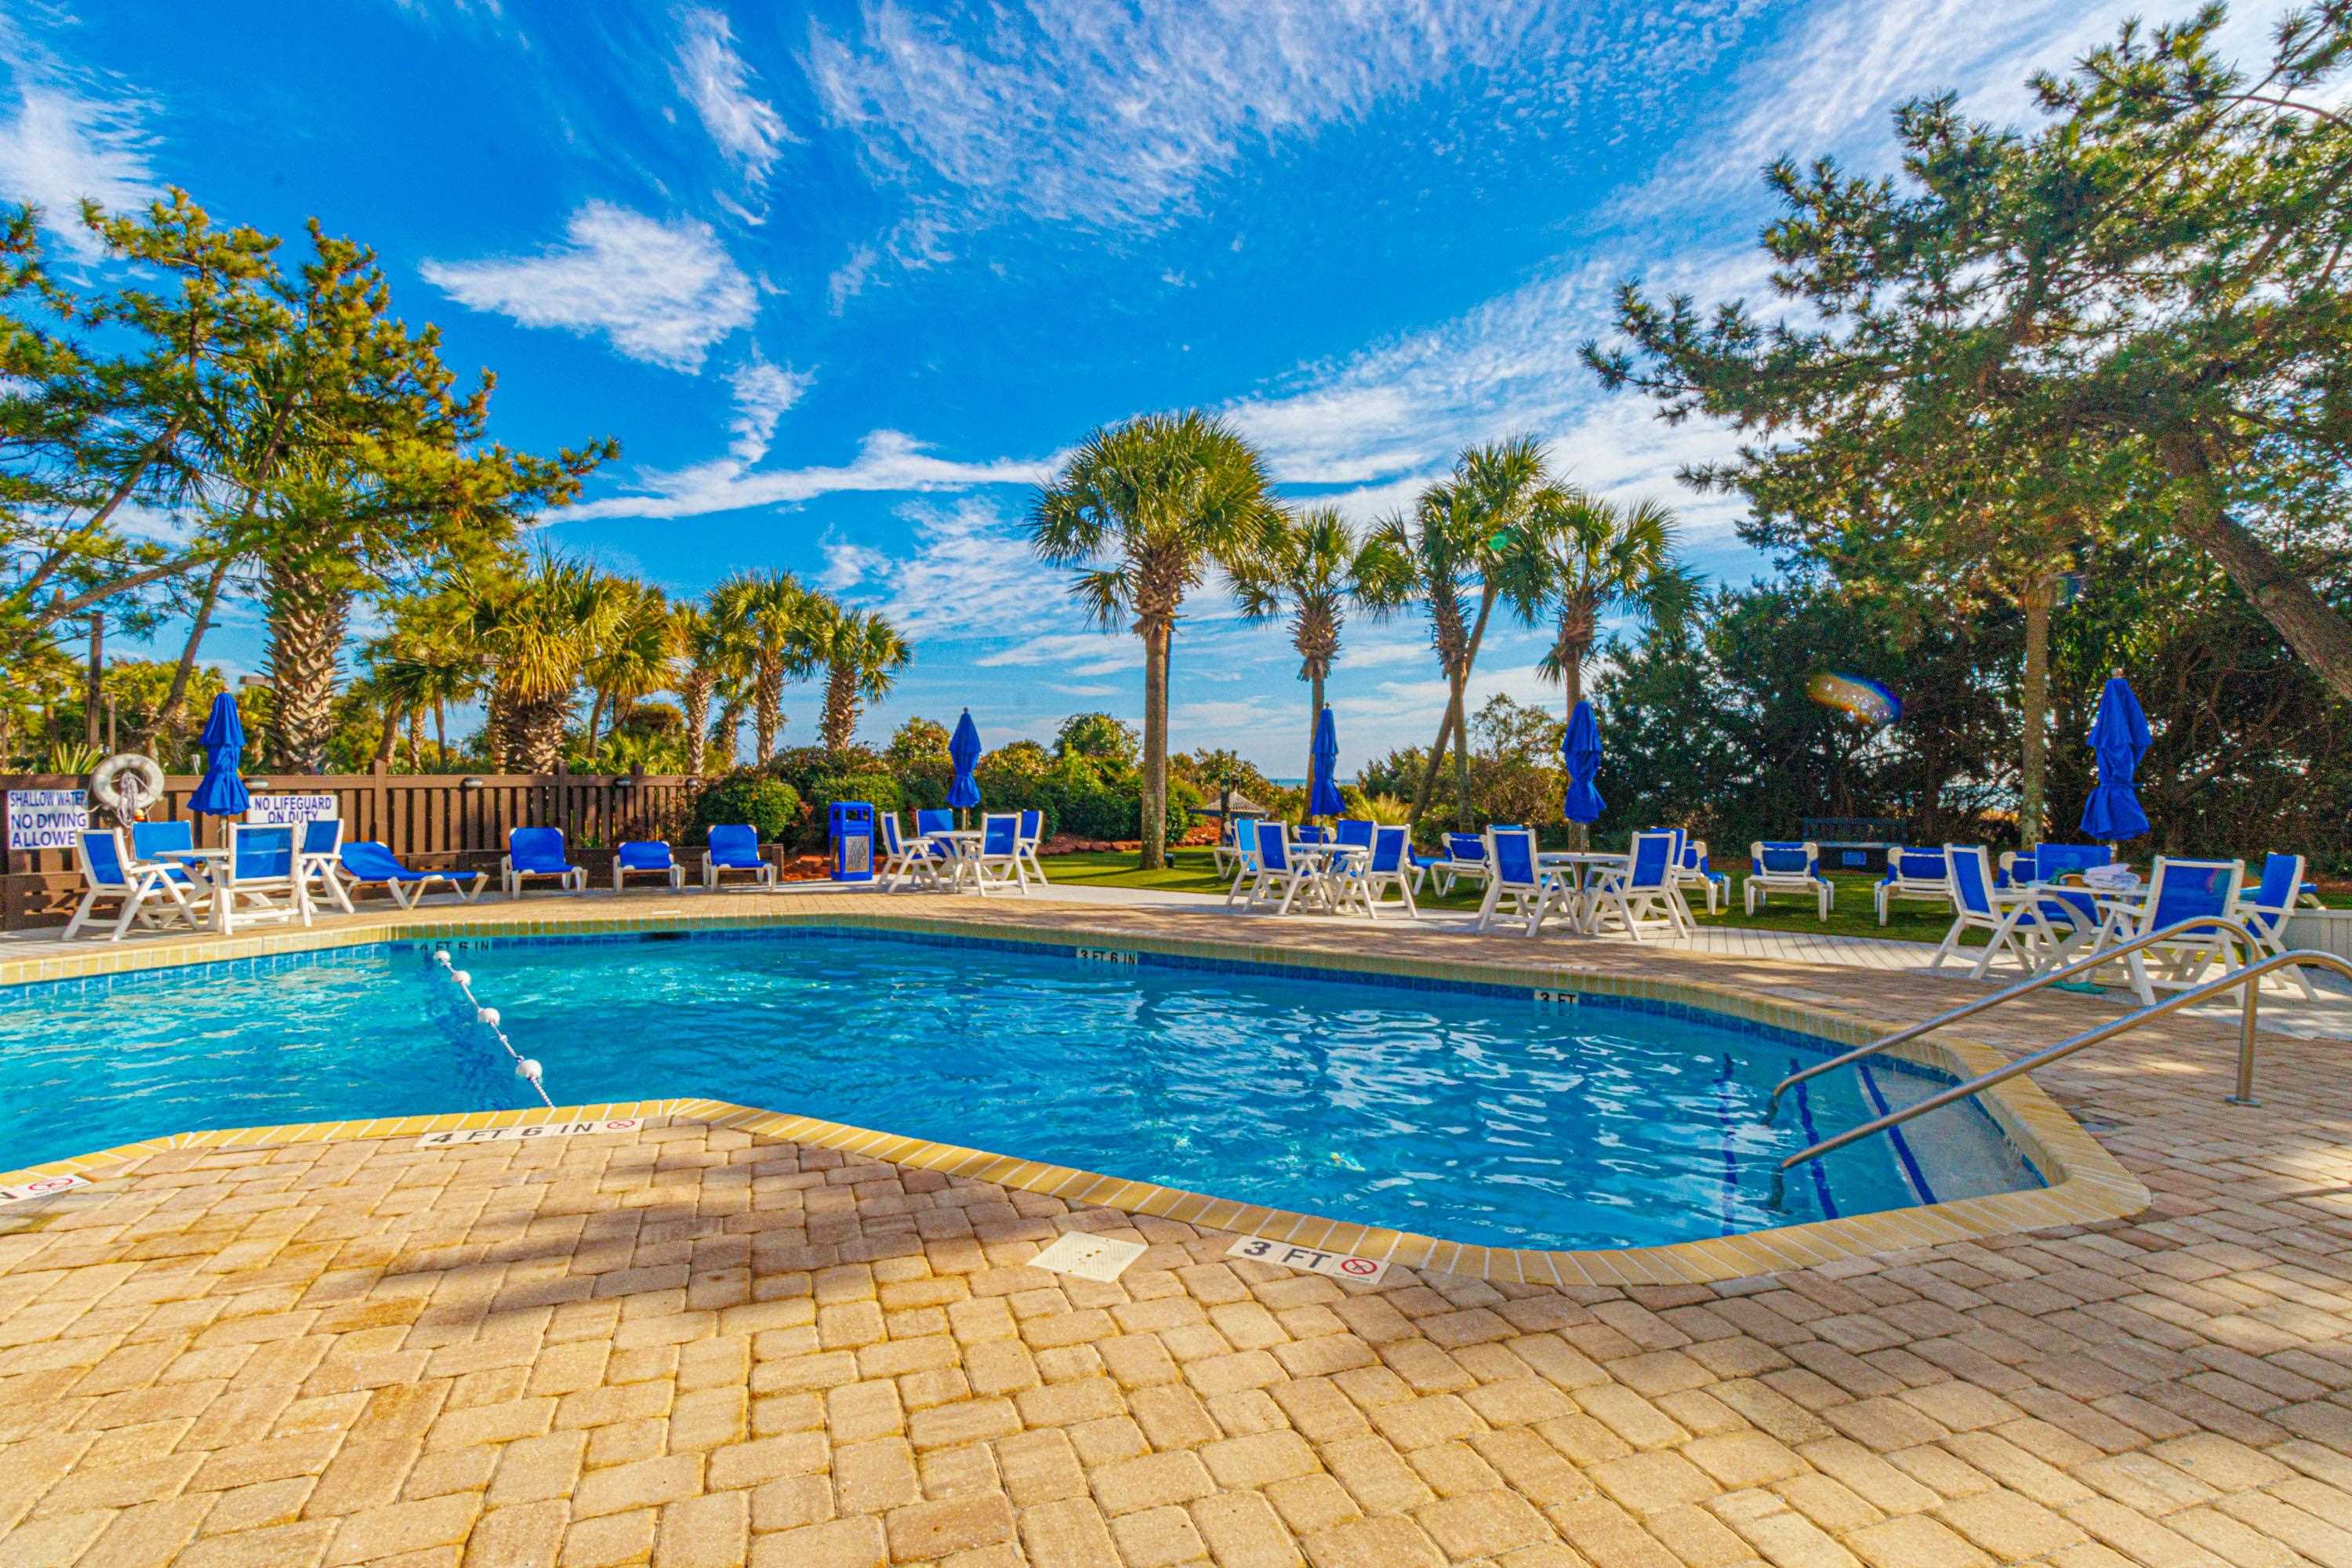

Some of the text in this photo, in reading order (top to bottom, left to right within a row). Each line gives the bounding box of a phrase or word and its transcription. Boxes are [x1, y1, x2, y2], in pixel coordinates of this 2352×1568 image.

[10, 791, 54, 807] SHALLOW
[255, 797, 332, 810] NO LIFEGUARD
[11, 813, 86, 829] NO DIVING
[268, 810, 318, 823] ON DUTY
[12, 831, 76, 847] ALLOWE
[435, 941, 452, 950] FT
[475, 940, 489, 950] IN
[1080, 949, 1136, 964] 3 FT 6 IN
[1540, 992, 1576, 1004] 3 FT
[430, 1133, 454, 1143] 4
[466, 1128, 510, 1141] FT
[560, 1123, 593, 1134] IN
[1243, 1241, 1332, 1268] 3 FT
